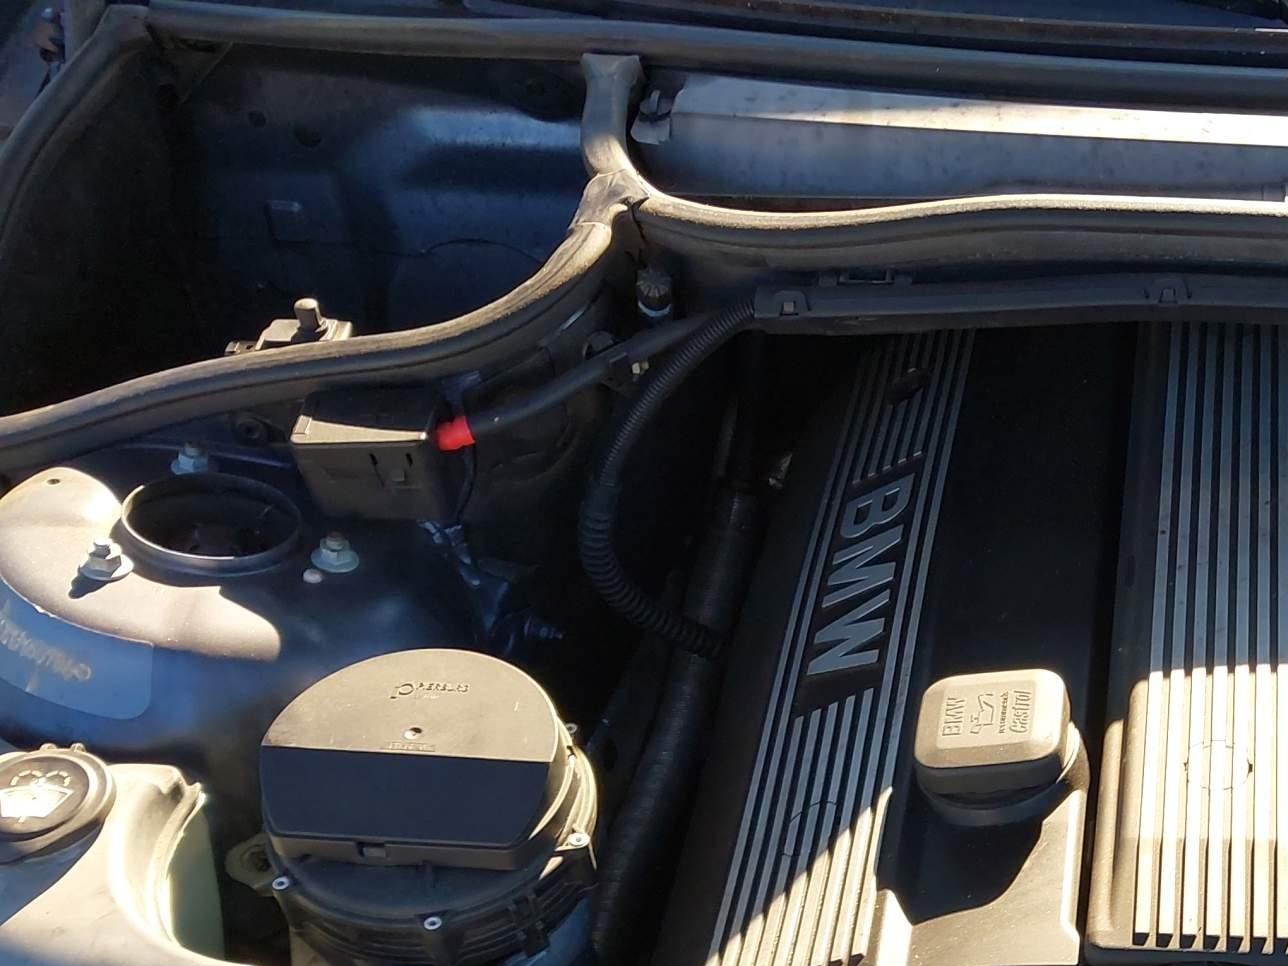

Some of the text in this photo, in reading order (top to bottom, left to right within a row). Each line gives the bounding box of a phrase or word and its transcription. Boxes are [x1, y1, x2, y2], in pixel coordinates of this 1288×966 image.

[807, 472, 916, 675] BMW
[942, 697, 965, 736] BMW
[1009, 690, 1032, 733] Castrol
